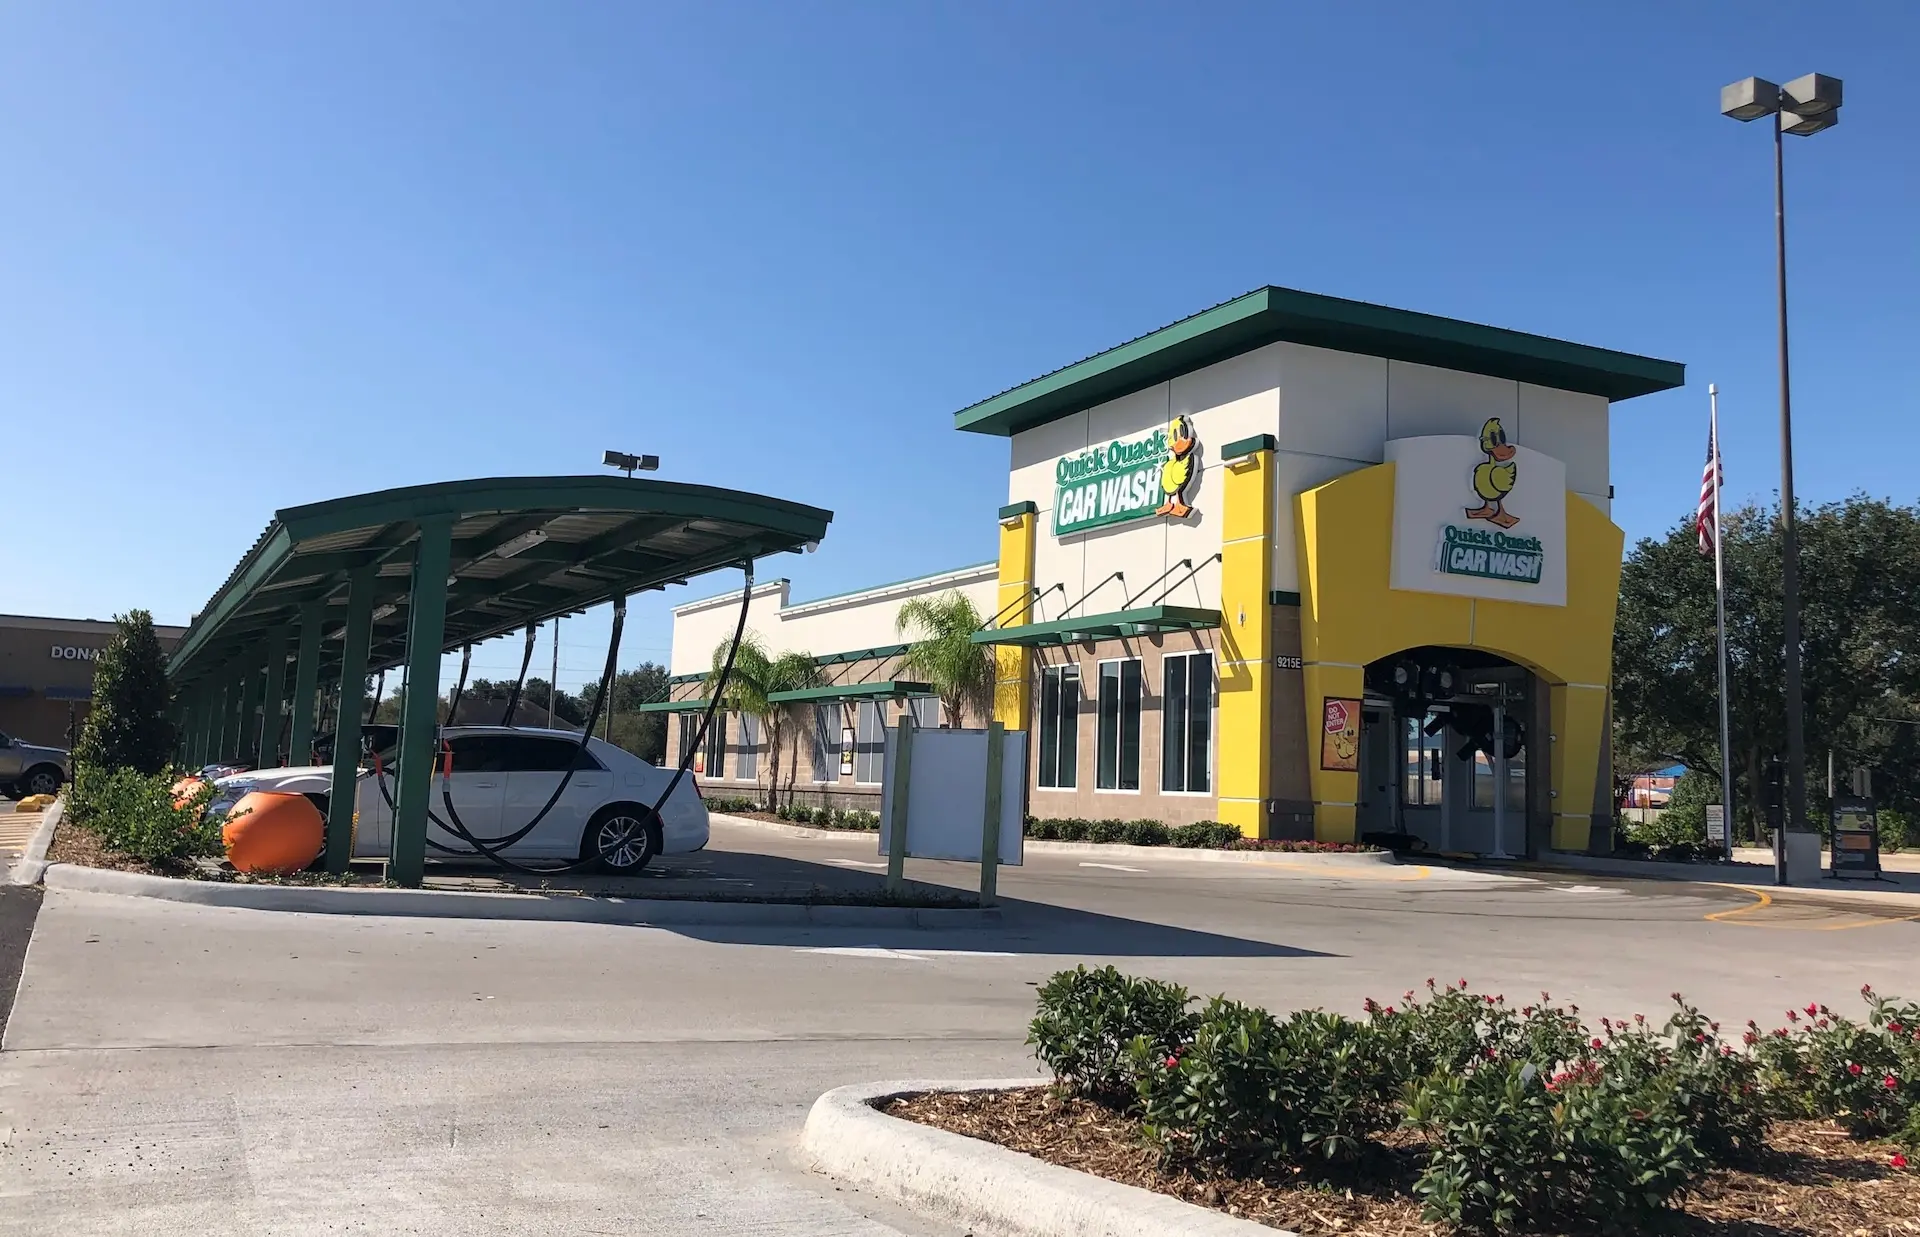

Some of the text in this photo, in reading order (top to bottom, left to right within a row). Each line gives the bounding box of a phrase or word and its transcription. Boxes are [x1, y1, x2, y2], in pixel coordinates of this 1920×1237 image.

[1056, 430, 1167, 485] Quick Quack
[1060, 468, 1162, 526] CAR WASH
[1445, 525, 1543, 551] Quick Quack
[1452, 548, 1540, 578] CAR WASH
[1277, 656, 1301, 669] 9215E
[1328, 706, 1338, 714] DO
[1328, 712, 1340, 720] NOT
[1326, 718, 1344, 728] ENTER
